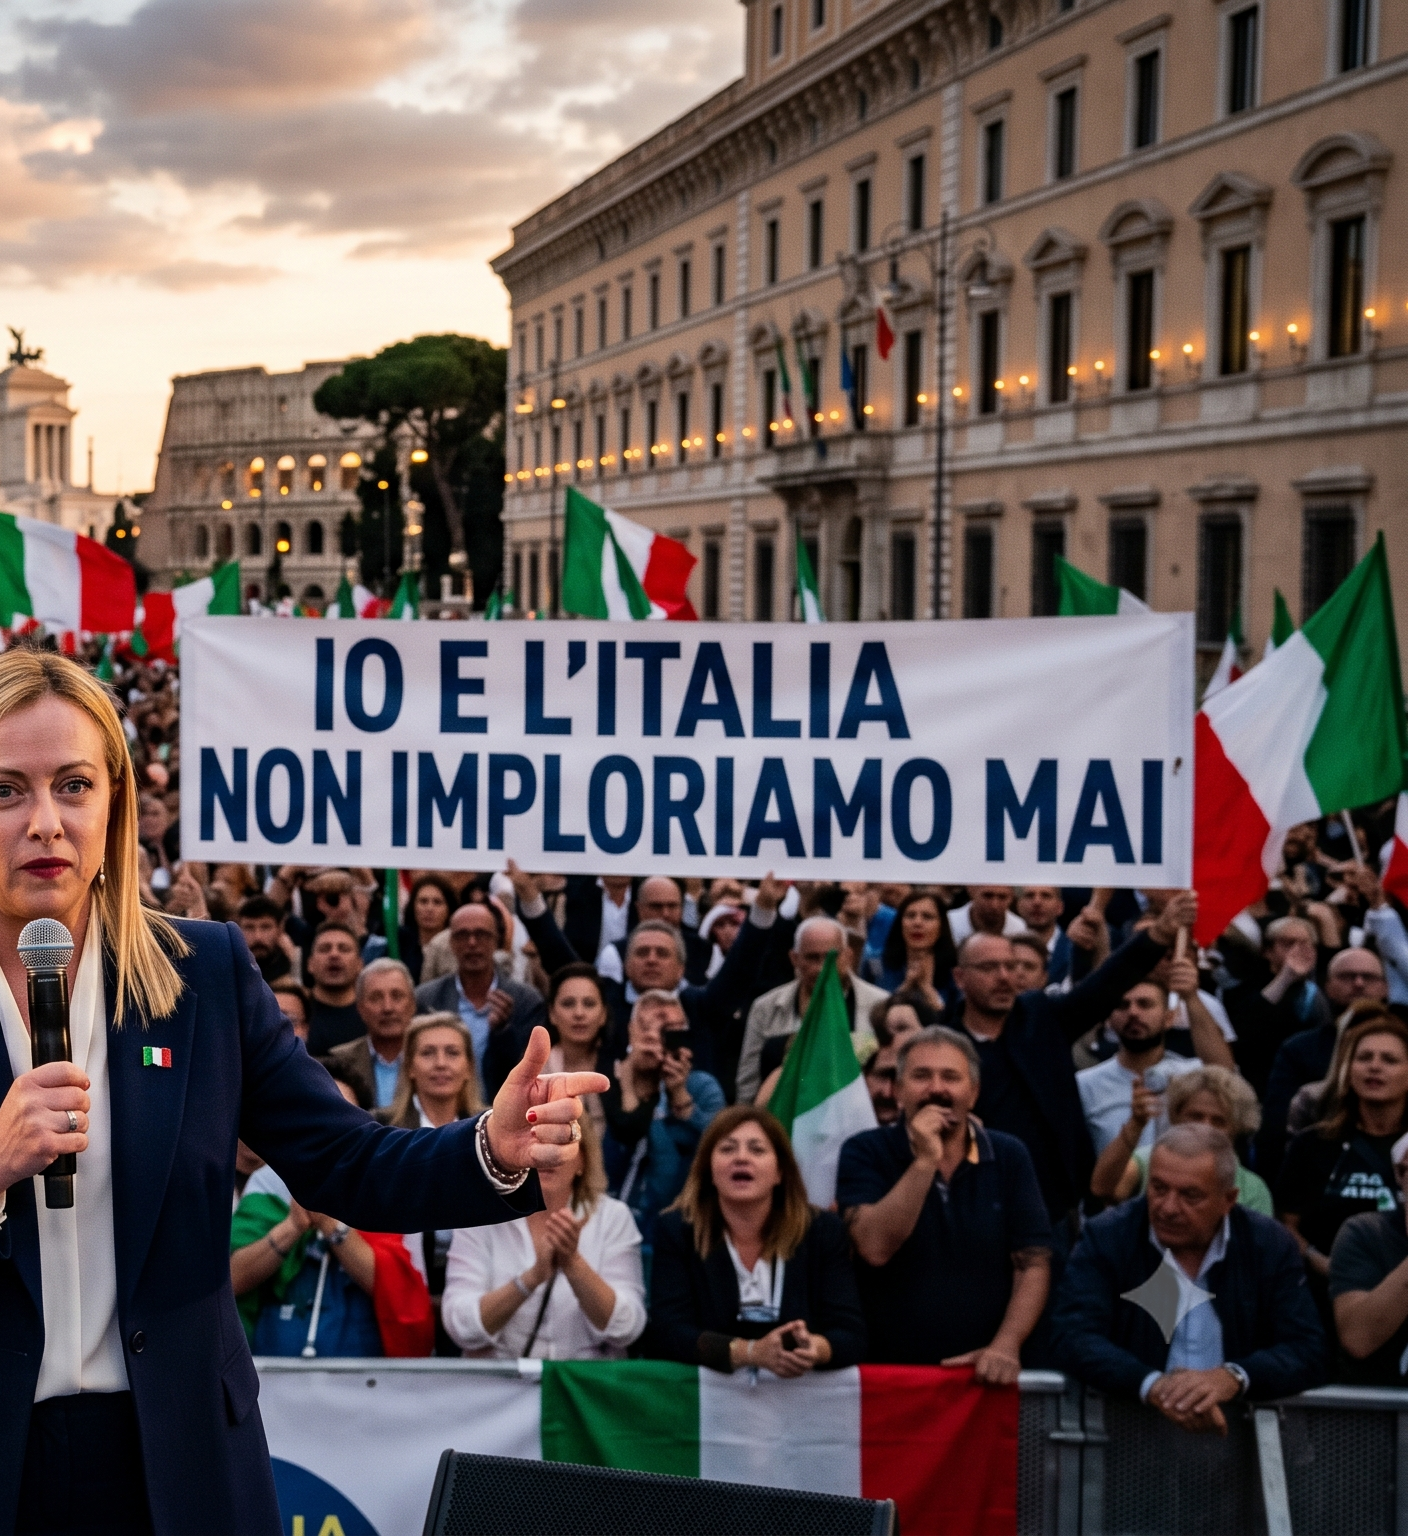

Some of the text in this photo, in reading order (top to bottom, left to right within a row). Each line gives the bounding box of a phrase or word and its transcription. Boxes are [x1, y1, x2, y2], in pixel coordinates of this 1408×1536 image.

[315, 637, 911, 740] IO E L'ITALIA
[199, 747, 1164, 866] NON IMPLORIAMO MAI
